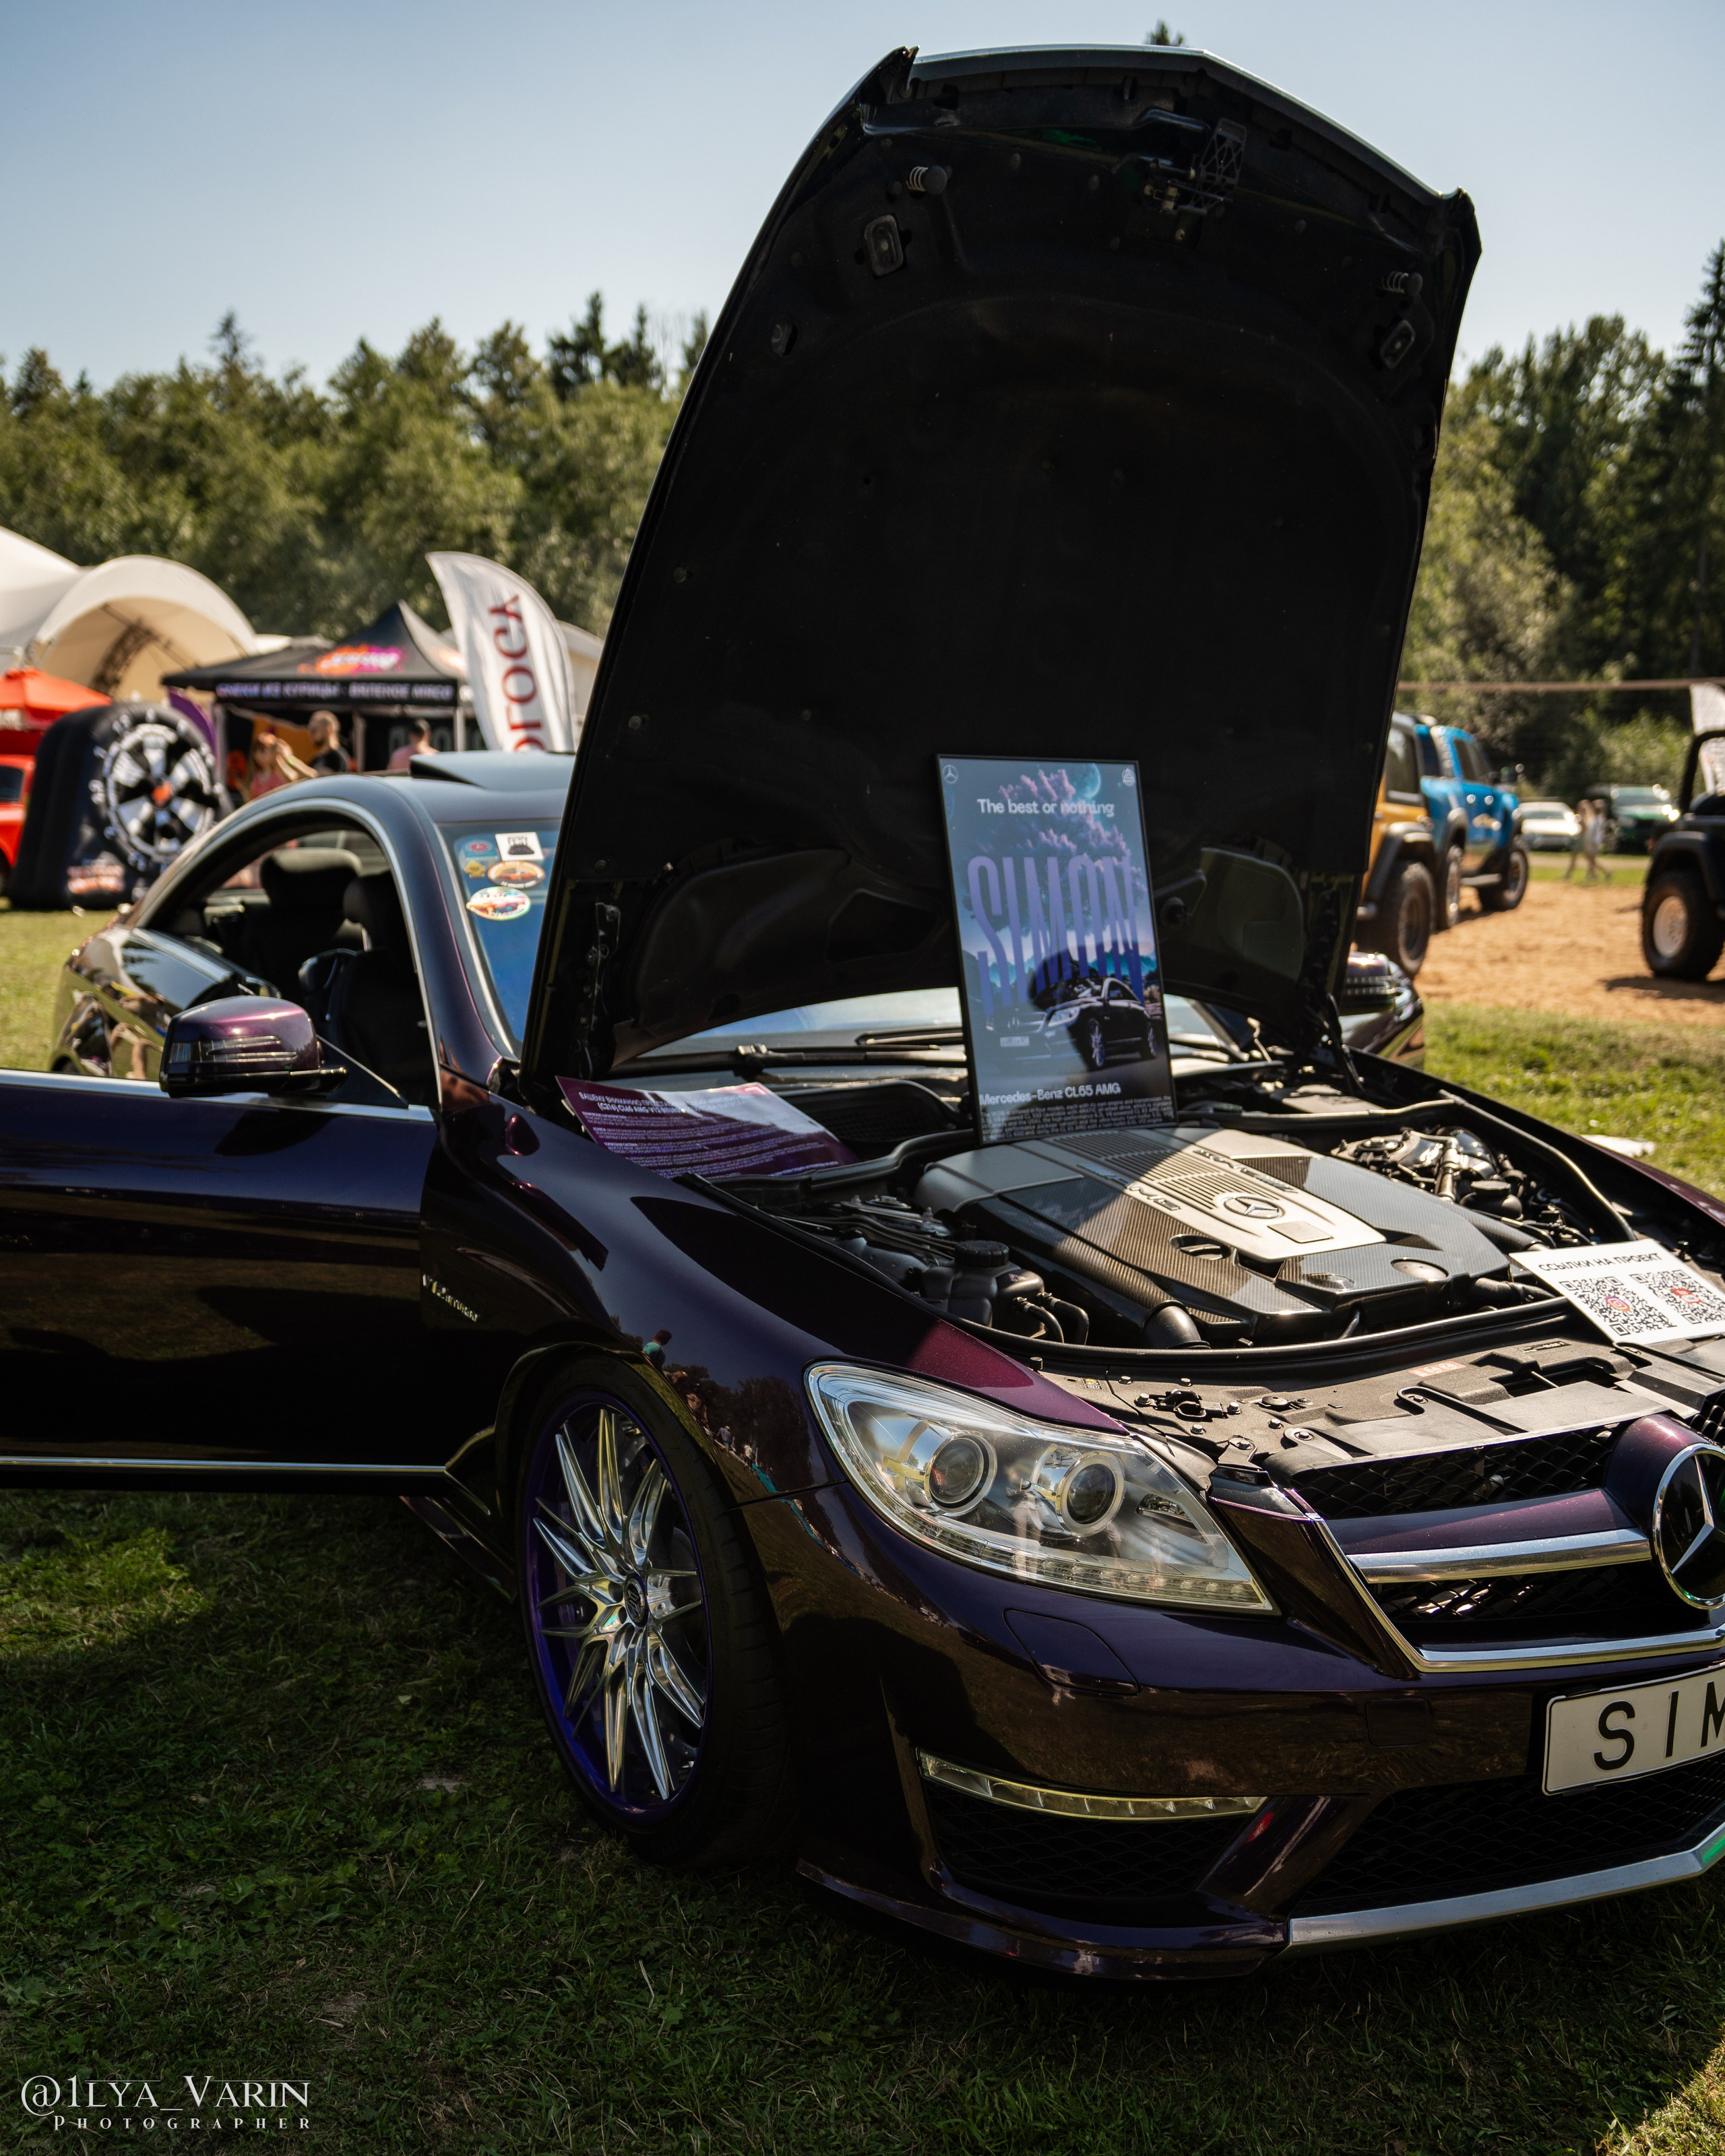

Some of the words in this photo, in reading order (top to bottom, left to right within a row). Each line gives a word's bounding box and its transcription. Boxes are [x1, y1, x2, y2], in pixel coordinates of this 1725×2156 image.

[977, 798, 1005, 814] The
[1008, 799, 1039, 814] best
[1042, 802, 1057, 814] or
[1060, 800, 1115, 818] nothing
[967, 856, 1145, 1018] SIMON
[980, 1089, 1063, 1105] Mercedes-Benz
[1065, 1085, 1094, 1098] CL65
[1095, 1082, 1121, 1096] AMG
[1538, 1259, 1592, 1271] ССЫЛКИ
[1593, 1258, 1614, 1267] НА
[1613, 1253, 1663, 1265] ПРОЕКТ
